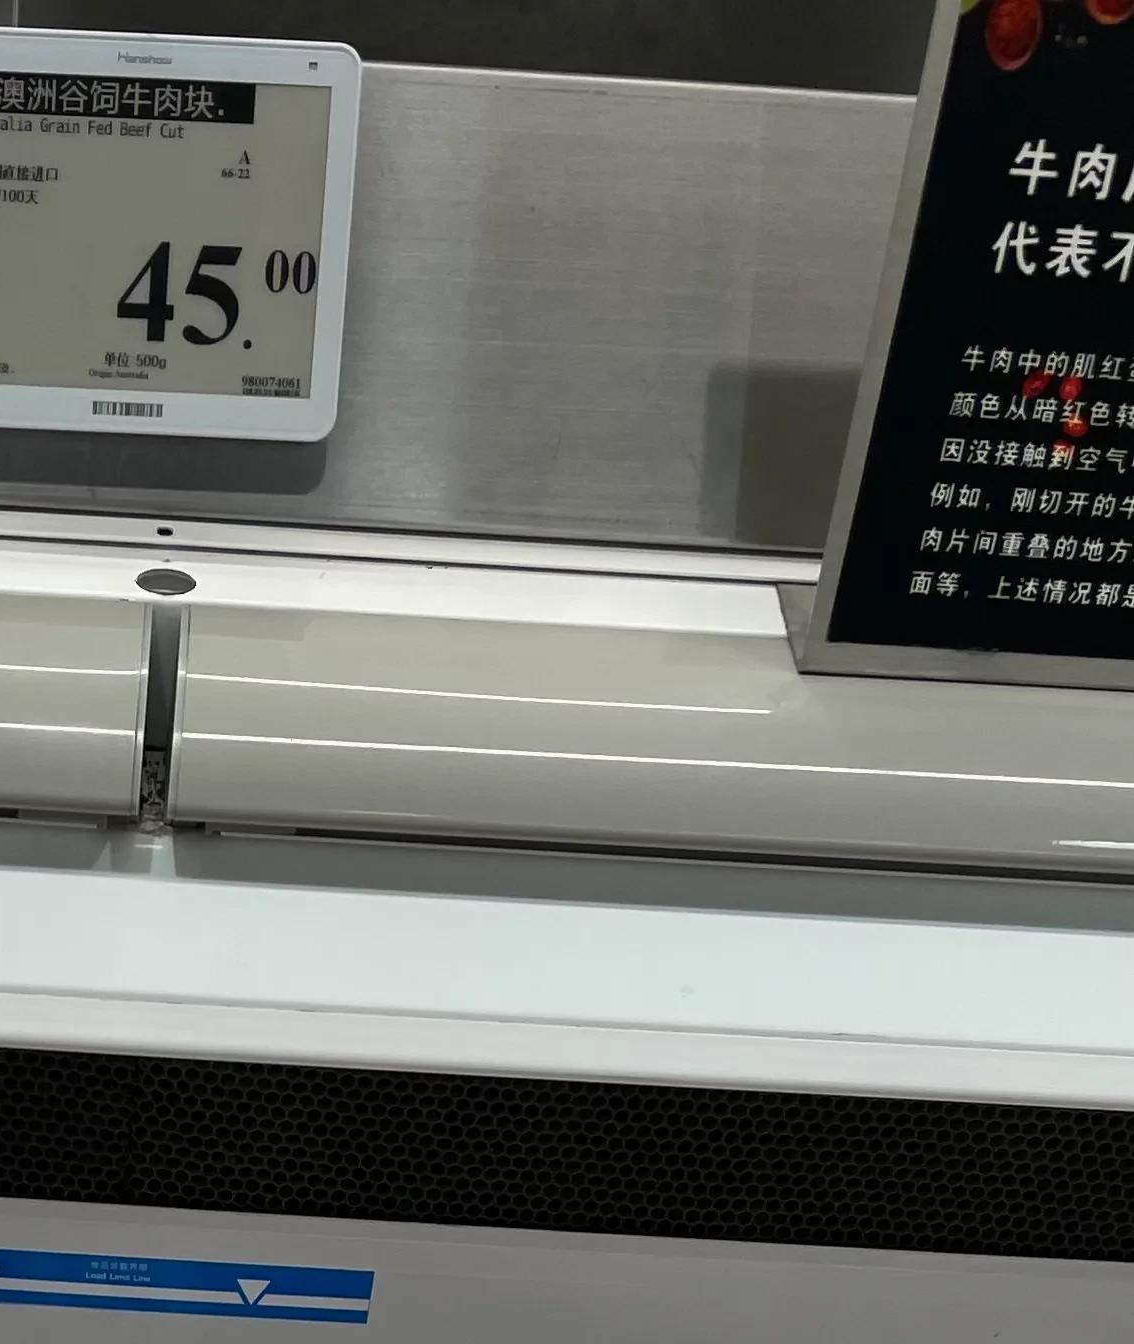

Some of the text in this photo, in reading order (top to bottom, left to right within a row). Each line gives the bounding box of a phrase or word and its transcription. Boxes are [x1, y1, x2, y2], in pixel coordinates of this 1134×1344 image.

[118, 51, 172, 65] Hanshow
[40, 118, 80, 135] Grain
[88, 120, 113, 136] Fed
[120, 122, 152, 138] Beef
[160, 123, 184, 139] Cut
[239, 150, 251, 165] A
[1009, 138, 1134, 202] 牛肉
[136, 353, 167, 370] 500g
[962, 345, 1134, 382] 牛肉中的肌红
[939, 438, 1134, 475] 因没接触到空气
